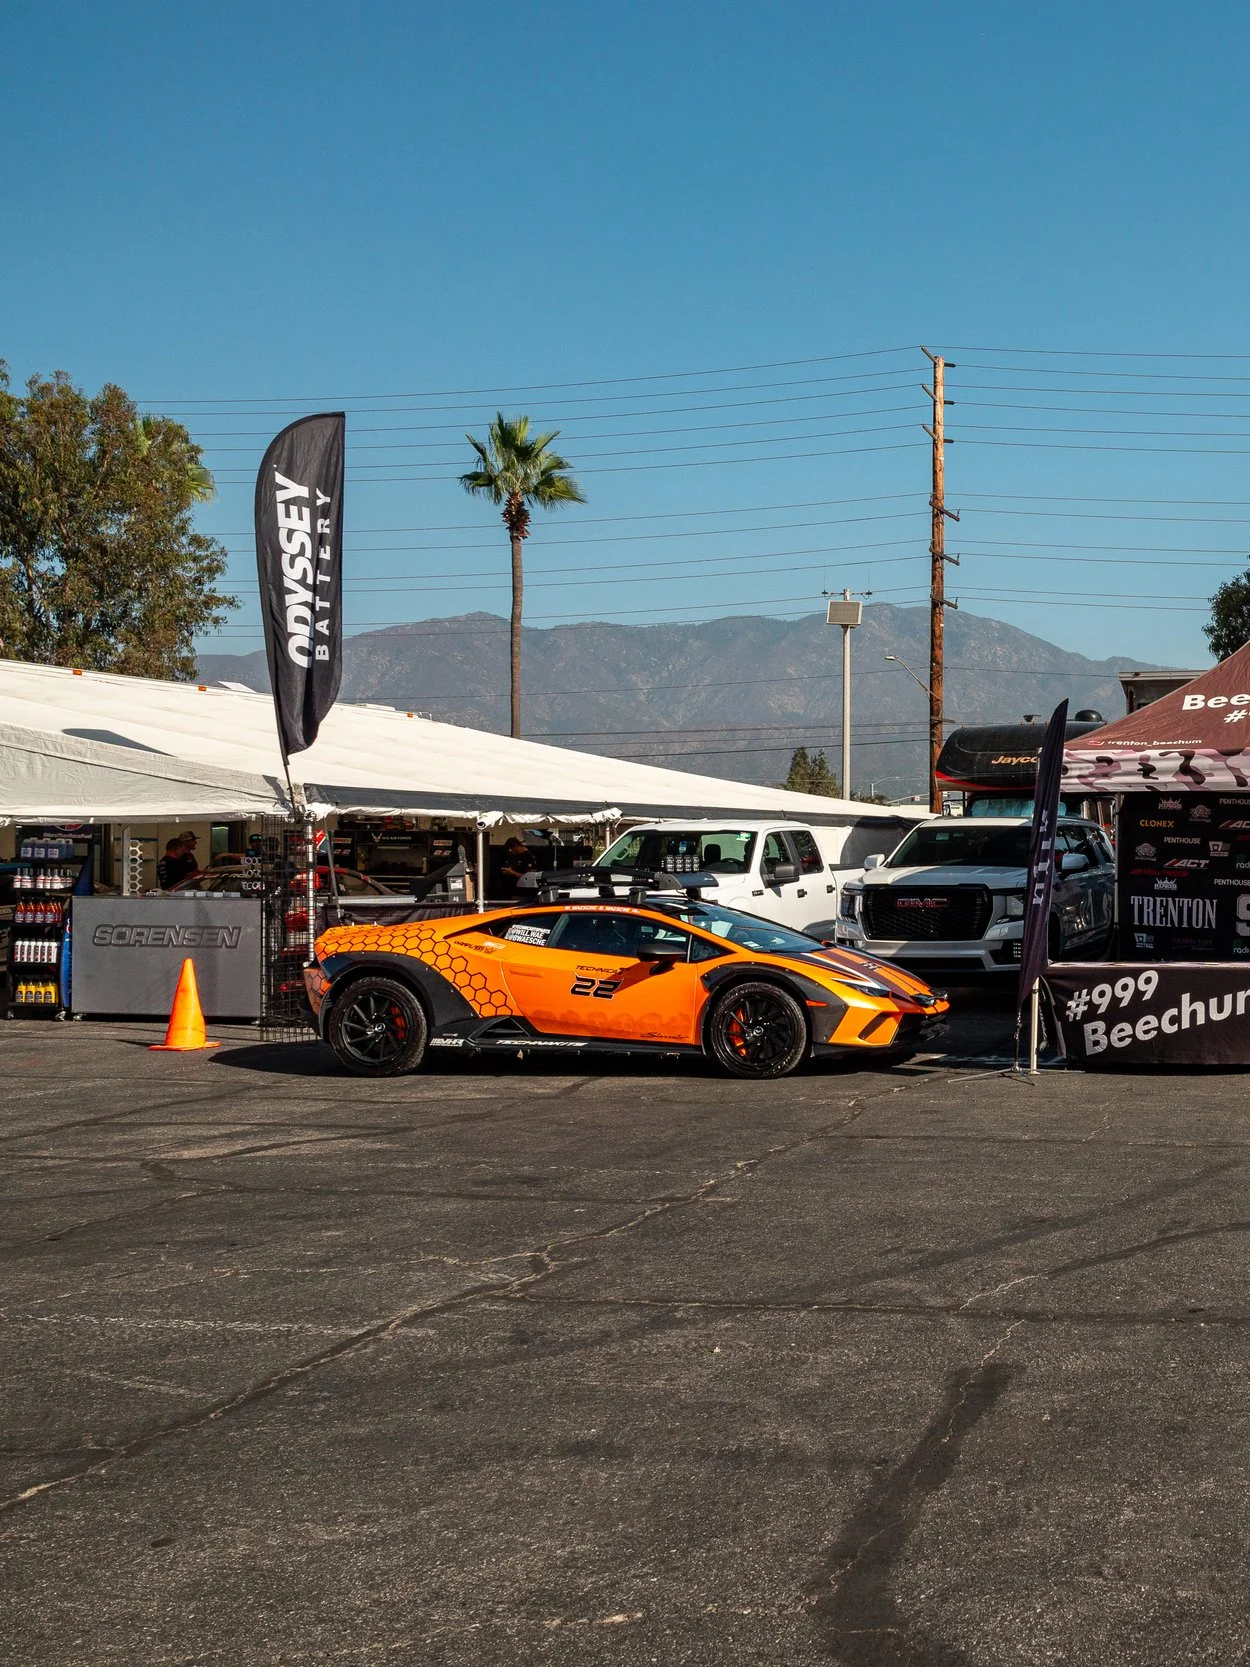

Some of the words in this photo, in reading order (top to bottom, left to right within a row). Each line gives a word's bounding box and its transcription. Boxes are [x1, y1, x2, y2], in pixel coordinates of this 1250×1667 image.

[274, 471, 314, 668] ODYSSEY
[315, 488, 332, 661] BATTERY
[1107, 739, 1202, 747] trenton_beechum
[1139, 818, 1175, 828] CLONEX
[1164, 836, 1201, 845] PENTHOUSE
[896, 898, 948, 909] GMC
[1131, 895, 1218, 929] TRENTON
[92, 924, 243, 949] SORENSEN
[569, 972, 625, 1000] 22
[1065, 970, 1159, 1022] #999
